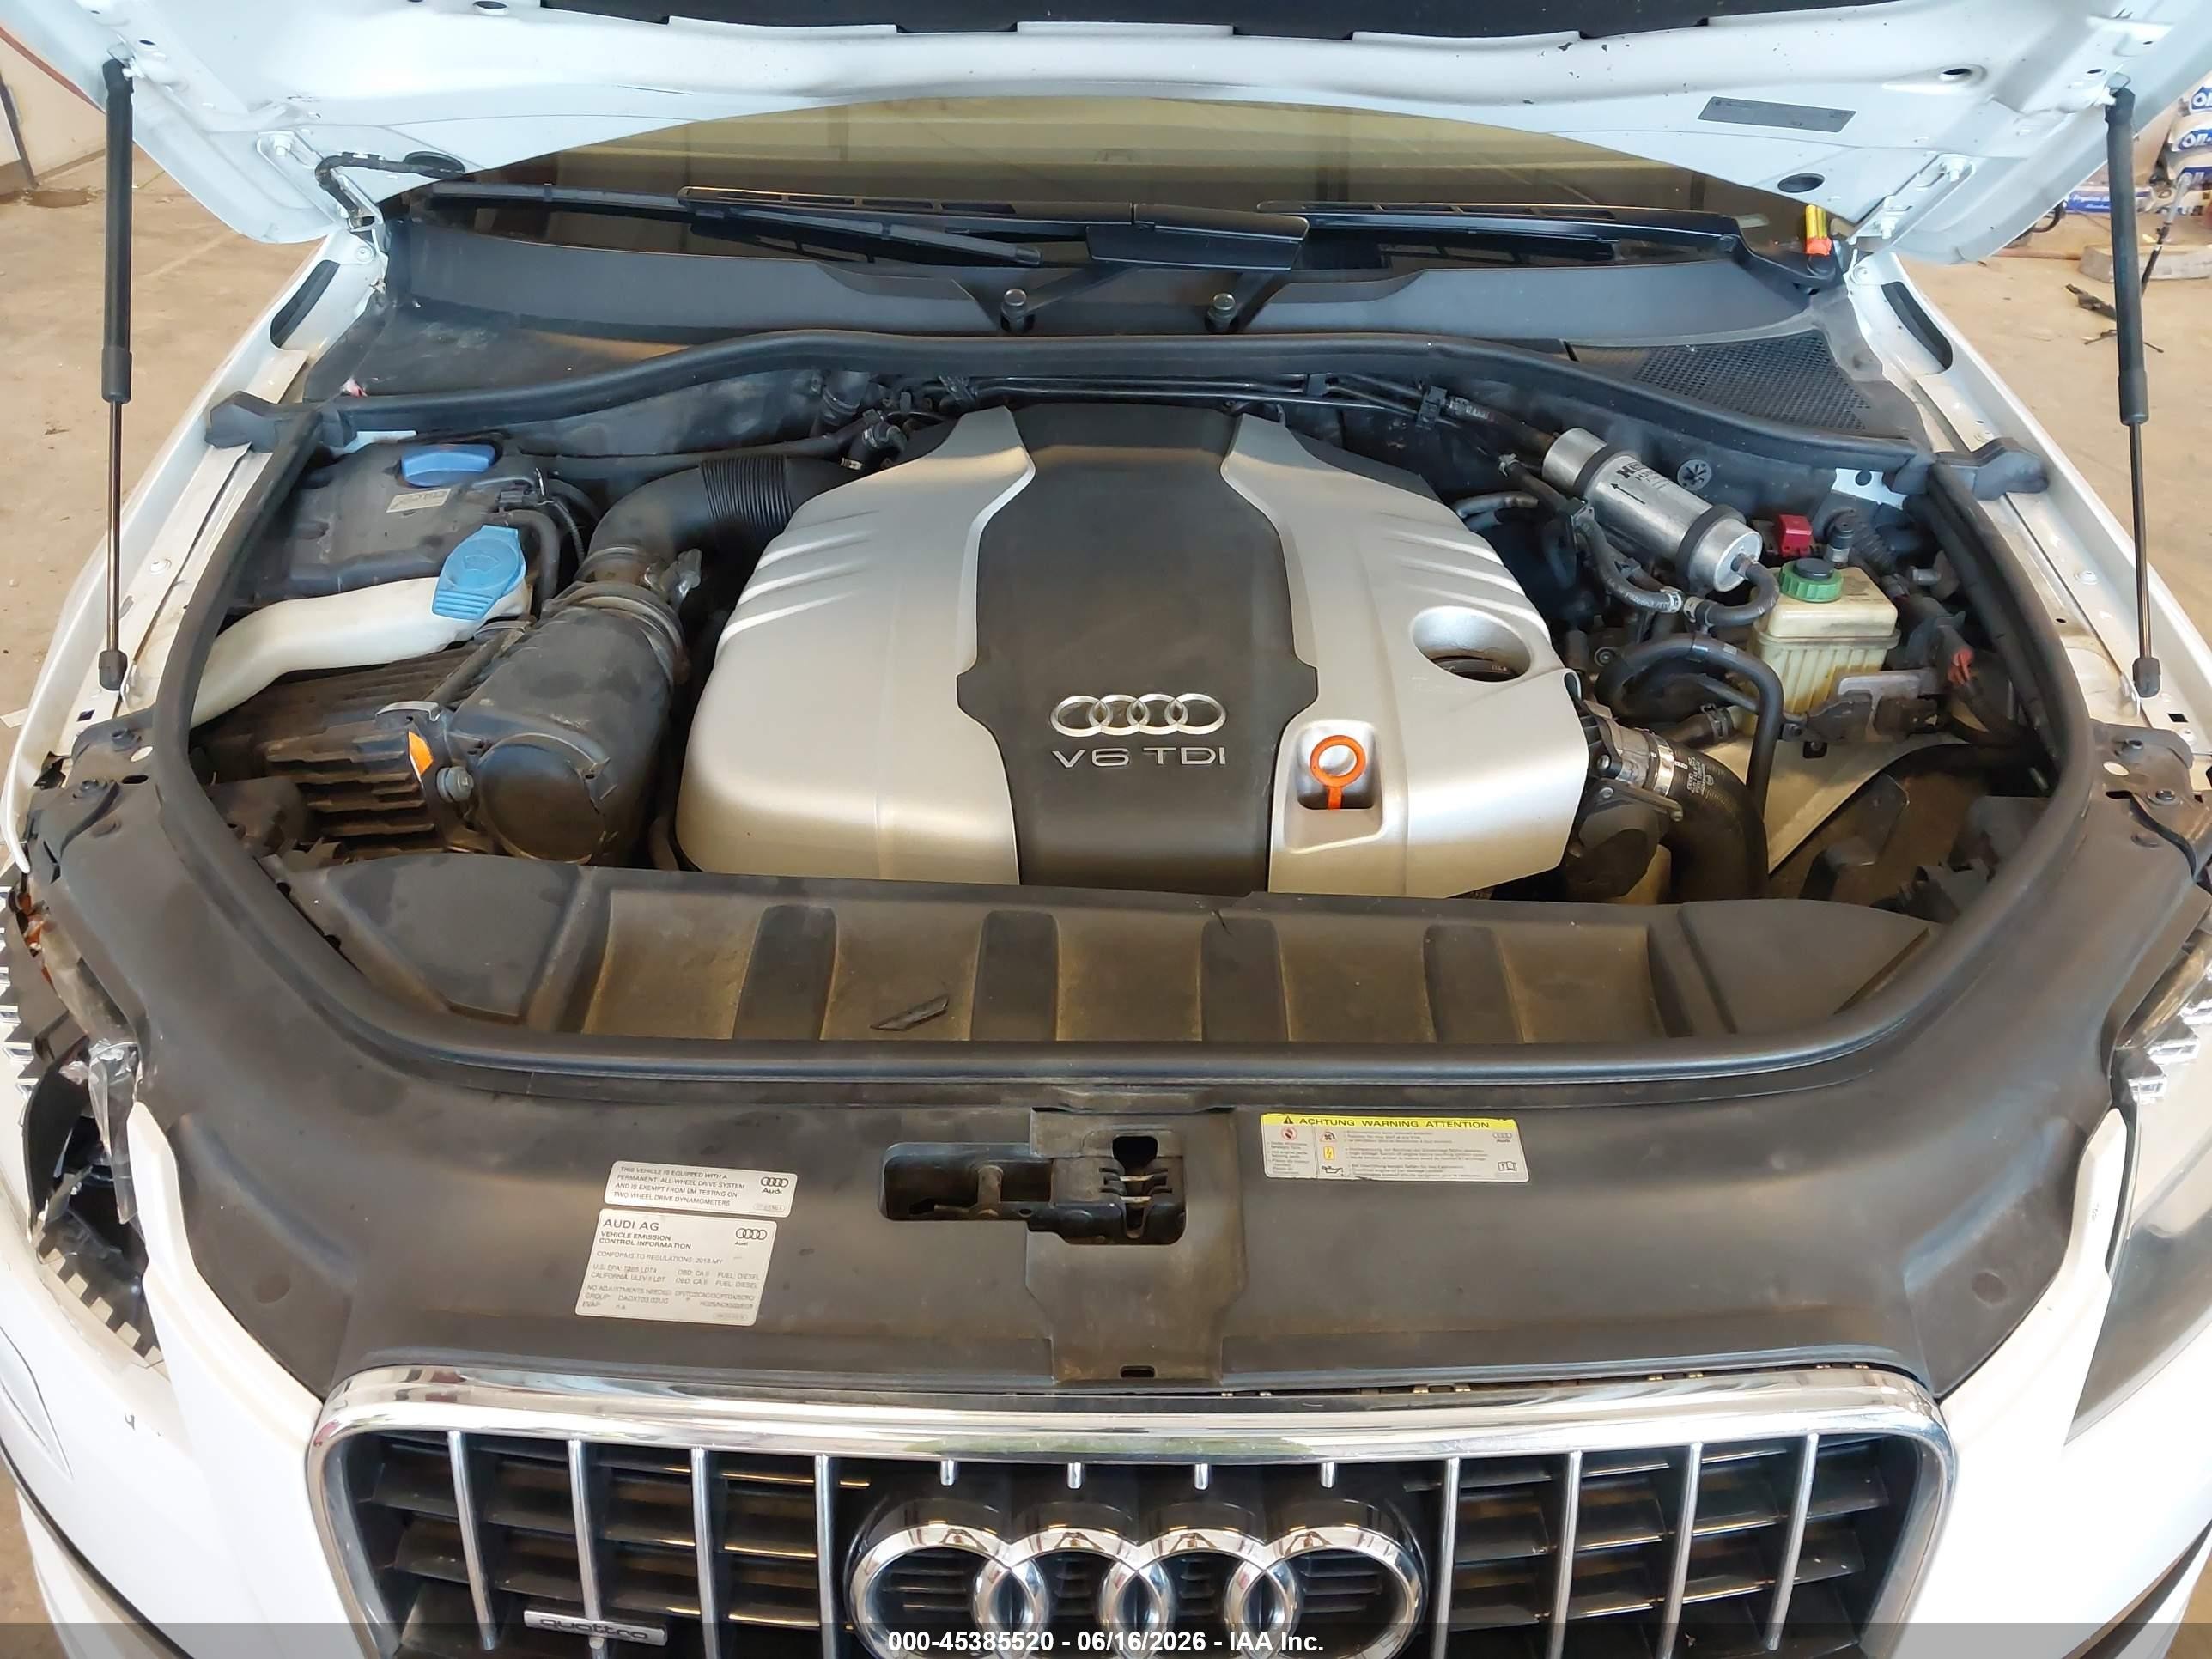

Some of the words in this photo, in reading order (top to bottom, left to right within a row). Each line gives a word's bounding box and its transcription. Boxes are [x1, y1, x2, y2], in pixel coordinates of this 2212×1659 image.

[1051, 747, 1130, 768] V6
[1143, 746, 1226, 765] TDI
[1299, 1118, 1355, 1127] ACHTUNG
[699, 1188, 726, 1197] TESTING
[603, 1218, 635, 1229] AUDI
[639, 1221, 659, 1231] AG
[601, 1231, 632, 1239] VEHICLE
[633, 1233, 672, 1242] EMISSION
[599, 1237, 635, 1246] CONTROL
[637, 1240, 692, 1249] INFORMATION
[539, 1619, 648, 1639] quattro
